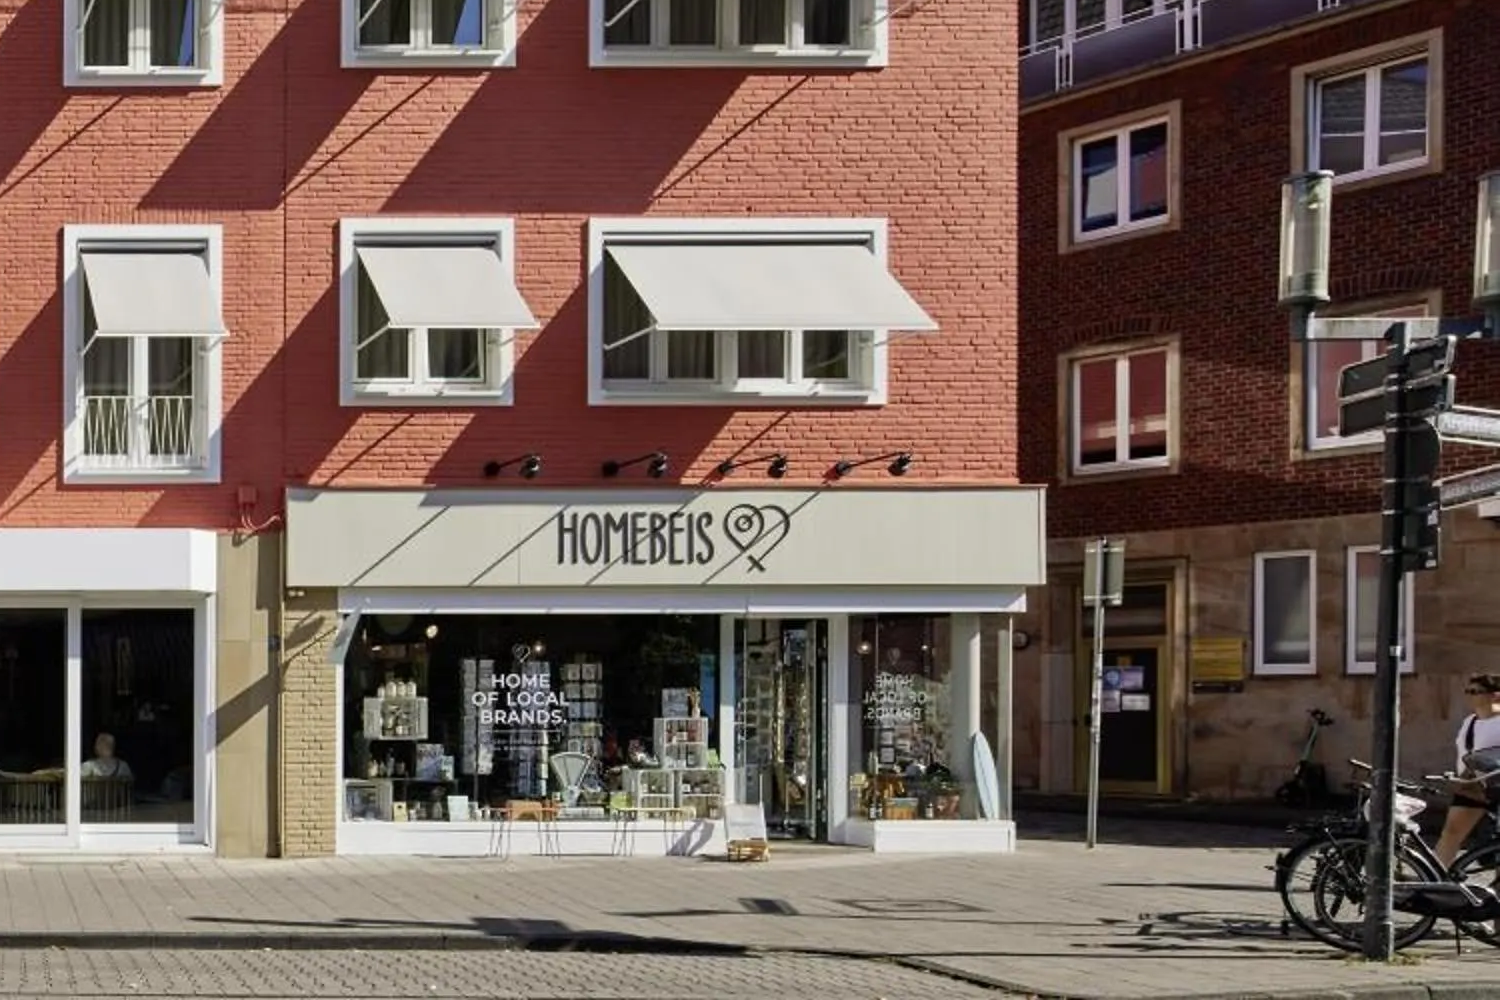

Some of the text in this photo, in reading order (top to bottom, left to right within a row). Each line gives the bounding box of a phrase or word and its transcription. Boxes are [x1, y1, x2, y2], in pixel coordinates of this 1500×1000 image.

[557, 510, 715, 566] HOMEBEIS
[491, 673, 551, 689] HOME
[471, 691, 570, 707] OF LOCAL
[480, 709, 567, 725] BRANDS.
